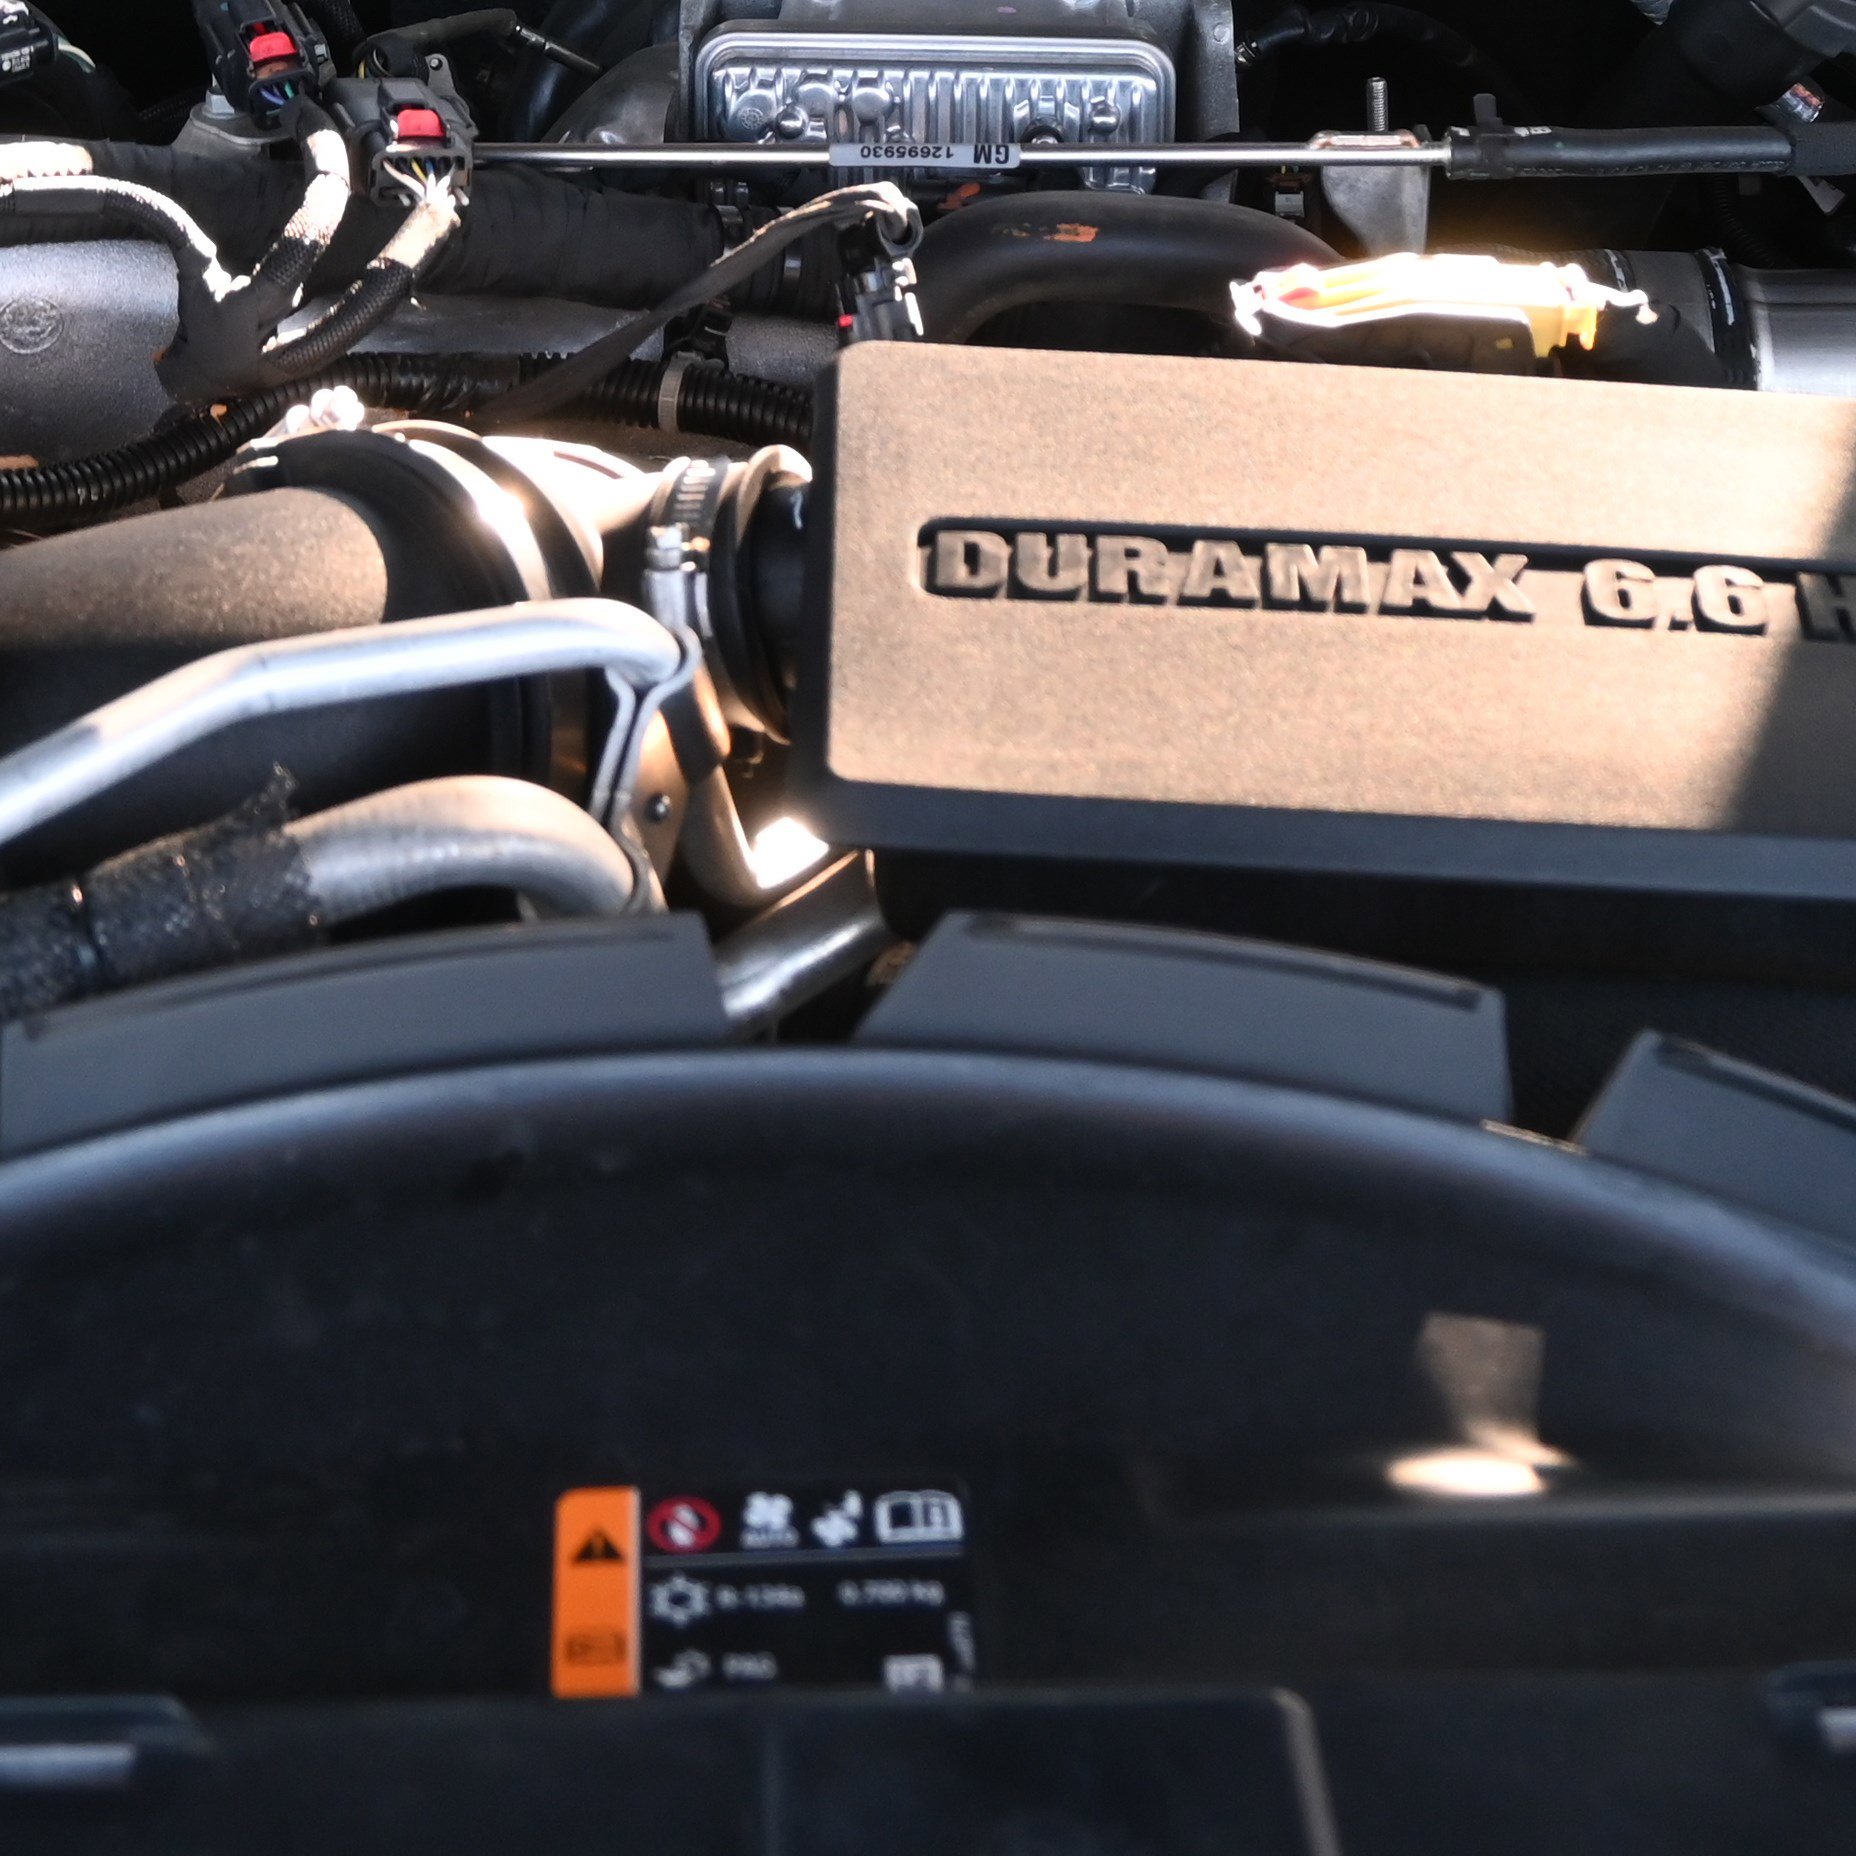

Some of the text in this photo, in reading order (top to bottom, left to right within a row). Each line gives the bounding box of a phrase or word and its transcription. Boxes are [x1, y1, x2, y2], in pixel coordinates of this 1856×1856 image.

[860, 144, 1010, 164] GM 12695930
[934, 530, 1536, 622] DURAMAX
[1581, 558, 1768, 636] 6.6
